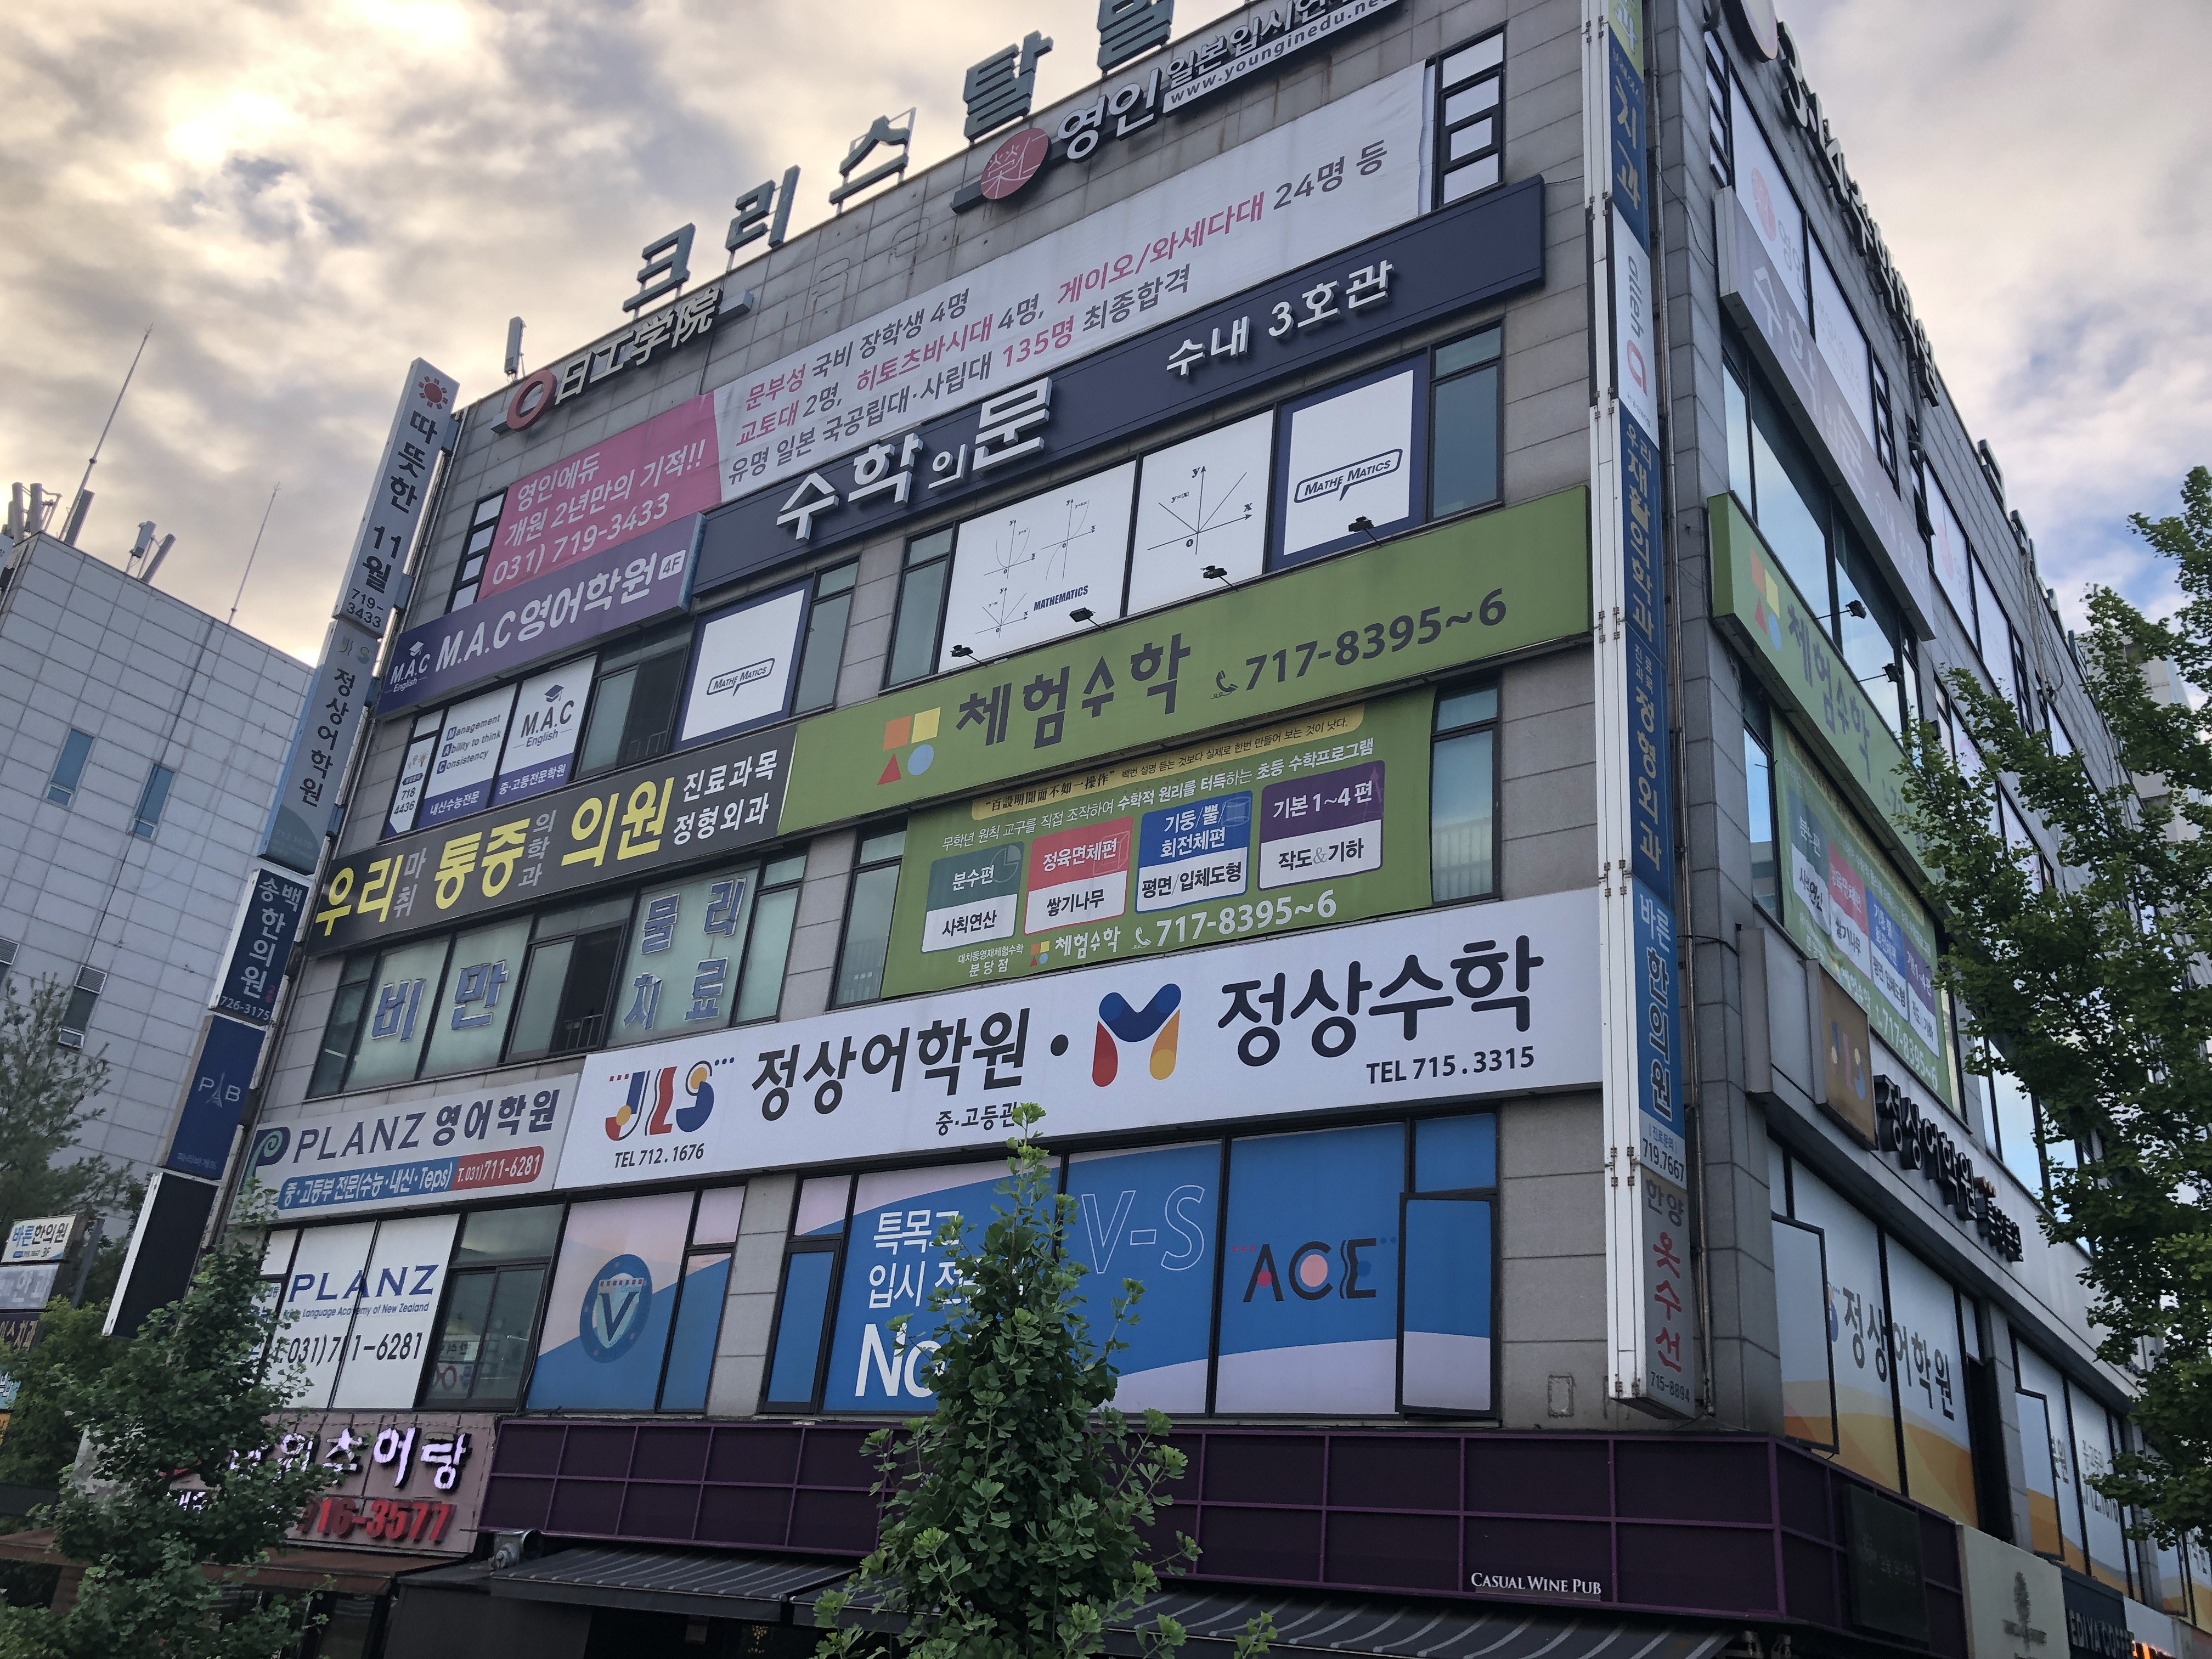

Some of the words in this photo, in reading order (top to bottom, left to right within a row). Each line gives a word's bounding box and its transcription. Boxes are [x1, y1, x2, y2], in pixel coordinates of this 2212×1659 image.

[1171, 0, 1389, 104] www.younginedu.ne
[1057, 67, 1161, 162] 영인
[1615, 75, 1640, 211] 치과
[736, 399, 798, 447] 교토대
[803, 383, 843, 417] 2명,
[857, 314, 994, 391] 히토츠바시대
[998, 294, 1044, 329] 4명,
[1057, 191, 1264, 305] 게이오/와세다대
[1273, 155, 1345, 210] 24명
[1356, 139, 1388, 176] 등
[1166, 316, 1250, 377] 수내
[1268, 259, 1395, 337] 3호관
[1628, 255, 1644, 338] olleh
[555, 289, 720, 405] 日工学院
[729, 447, 769, 485] 유명
[777, 427, 816, 466] 일본
[1002, 316, 1074, 368] 135명
[1082, 263, 1190, 331] 최종합격
[746, 363, 806, 411] 문부성
[812, 341, 853, 377] 국비
[860, 308, 925, 359] 장학생
[930, 288, 970, 323] 4명
[391, 411, 438, 514] 따뜻한
[1627, 424, 1652, 471] 우리
[505, 508, 549, 546] 개원
[550, 469, 635, 529] 2년만의
[640, 439, 706, 487] 기적!!
[518, 452, 600, 511] 영인에듀
[363, 526, 402, 594] 11월
[493, 544, 545, 585] 031)
[552, 493, 670, 563] 719-3433
[662, 556, 684, 575] 4F
[1628, 448, 1653, 642] 재활의학과
[347, 603, 381, 629] 3433
[1034, 585, 1088, 611] MATHEMATICS
[1245, 588, 1506, 691] 717-8395~6
[390, 654, 430, 685] M.A.C
[393, 677, 417, 693] English
[956, 633, 1191, 749] 체험수학
[1788, 603, 1870, 783] 체험수학
[300, 668, 356, 807] 정상어학원
[442, 741, 469, 757] Ability
[472, 737, 480, 746] to
[481, 729, 501, 745] think
[447, 714, 500, 740] Management
[521, 700, 574, 738] M.A.C
[526, 730, 558, 748] English
[437, 749, 489, 774] Consistency
[684, 749, 777, 803] 진료과목
[1122, 766, 1137, 778] 백번
[1141, 763, 1156, 776] 설명
[1159, 759, 1175, 771] 듣는
[1178, 752, 1204, 767] 것보다
[1206, 746, 1232, 760] 실제로
[1234, 740, 1252, 754] 한번
[1255, 732, 1282, 748] 만들어
[1284, 728, 1302, 741] 보는
[1306, 723, 1324, 736] 것이
[1637, 686, 1661, 871] 정형외과
[394, 800, 415, 815] 4436
[401, 787, 416, 803] 718
[430, 790, 480, 815] 내신수능전문
[561, 777, 674, 867] 의원
[674, 792, 769, 845] 정형외과
[942, 832, 974, 851] 무학년
[978, 825, 1000, 843] 원칙
[1002, 818, 1036, 838] 교구를
[1041, 811, 1064, 828] 직접
[1066, 799, 1114, 823] 조작하여
[1117, 789, 1155, 811] 수학적
[1159, 779, 1196, 803] 원리를
[1200, 768, 1252, 792] 터득하는
[1256, 759, 1284, 781] 초등
[1289, 737, 1374, 769] 수학프로그램
[1273, 794, 1308, 820] 기본
[1354, 781, 1373, 803] 편
[435, 817, 531, 910] 통증
[518, 809, 556, 887] 의학과
[1042, 838, 1117, 872] 정육면체편
[1160, 827, 1225, 858] 회전체편
[258, 877, 303, 912] 송백
[315, 854, 403, 937] 우리
[393, 847, 427, 919] 마취
[952, 865, 994, 891] 분수편
[1046, 889, 1104, 917] 쌓기나무
[641, 878, 747, 954] 물리
[942, 910, 997, 938] 사칙연산
[1055, 926, 1121, 960] 체험수학
[1156, 889, 1336, 946] 717-8395~6
[1640, 893, 1669, 952] 바른
[240, 908, 286, 999] 한의원
[958, 944, 1024, 963] 대치동영재체험수학
[371, 959, 509, 1042] 비만
[623, 957, 729, 1030] 치료
[1218, 935, 1544, 1066] 정상수학
[1647, 946, 1673, 1122] 한의원
[752, 1008, 1030, 1121] 정상어학원
[1367, 1060, 1407, 1084] TEL
[1413, 1046, 1534, 1080] 715.3315
[292, 1111, 426, 1163] PLANZ
[433, 1089, 560, 1147] 영어학원
[606, 1061, 714, 1141] JLS
[614, 1150, 636, 1168] TEL
[1643, 1138, 1685, 1182] 719.7667
[1646, 1179, 1684, 1227] 한양
[12, 1222, 69, 1247] 바른한의원
[41, 1247, 51, 1257] 3F
[287, 1265, 439, 1302] PLANZ
[869, 1261, 926, 1308] 입시
[1243, 1238, 1376, 1303] ACE
[302, 1308, 336, 1319] Language
[337, 1304, 371, 1316] Acaemy
[373, 1304, 381, 1313] of
[382, 1304, 396, 1313] New
[399, 1302, 429, 1312] Zealand
[1653, 1232, 1682, 1373] 옷수선
[1843, 1286, 1954, 1421] 정상어학원
[1650, 1371, 1690, 1403] 715-8894
